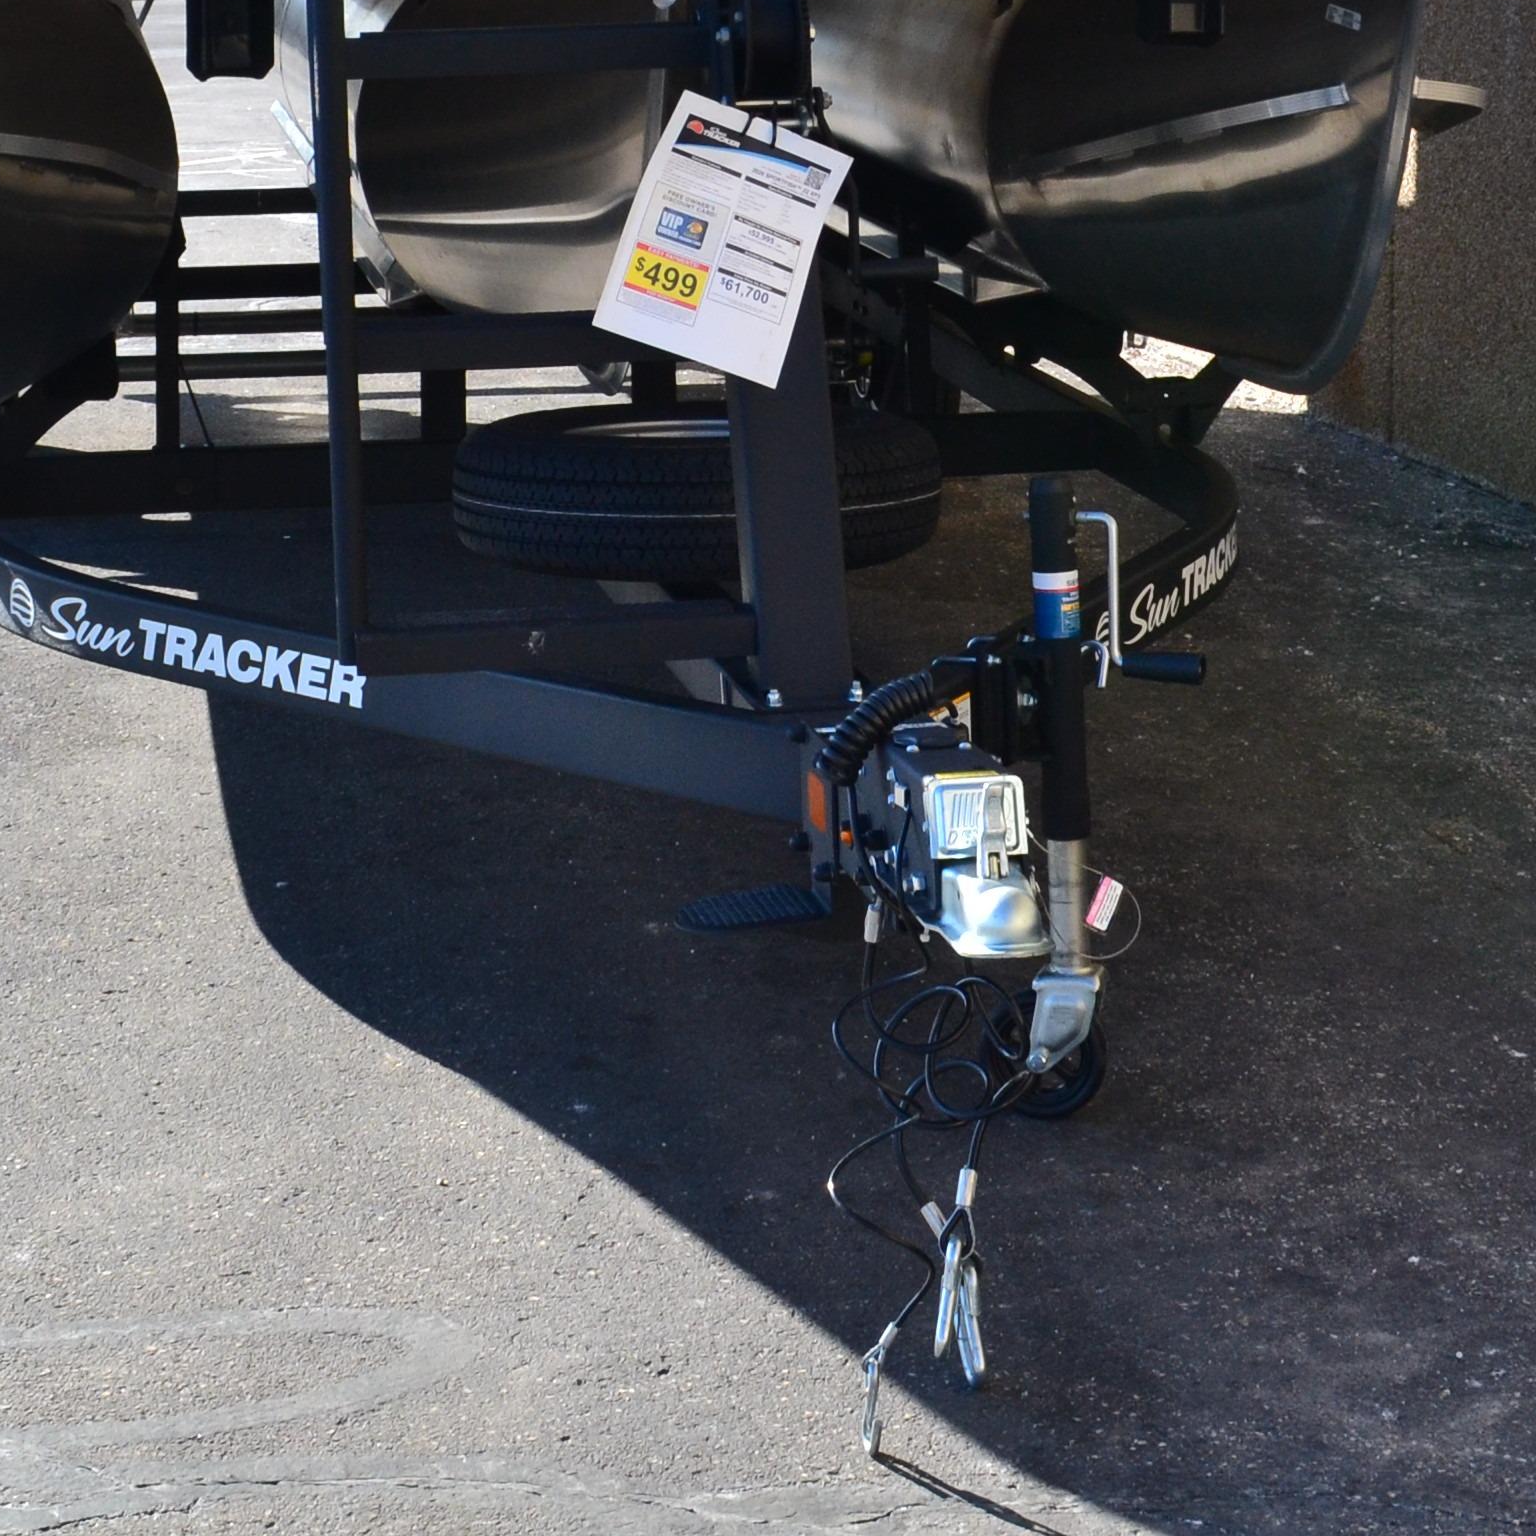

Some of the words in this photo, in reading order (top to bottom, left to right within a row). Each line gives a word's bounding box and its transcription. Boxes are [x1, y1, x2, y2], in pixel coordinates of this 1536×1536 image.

[661, 211, 684, 230] VIP
[635, 256, 697, 298] $499
[720, 277, 769, 304] $61,700
[1123, 583, 1180, 645] Sun
[42, 597, 135, 657] Sun
[138, 618, 367, 709] TRACKER
